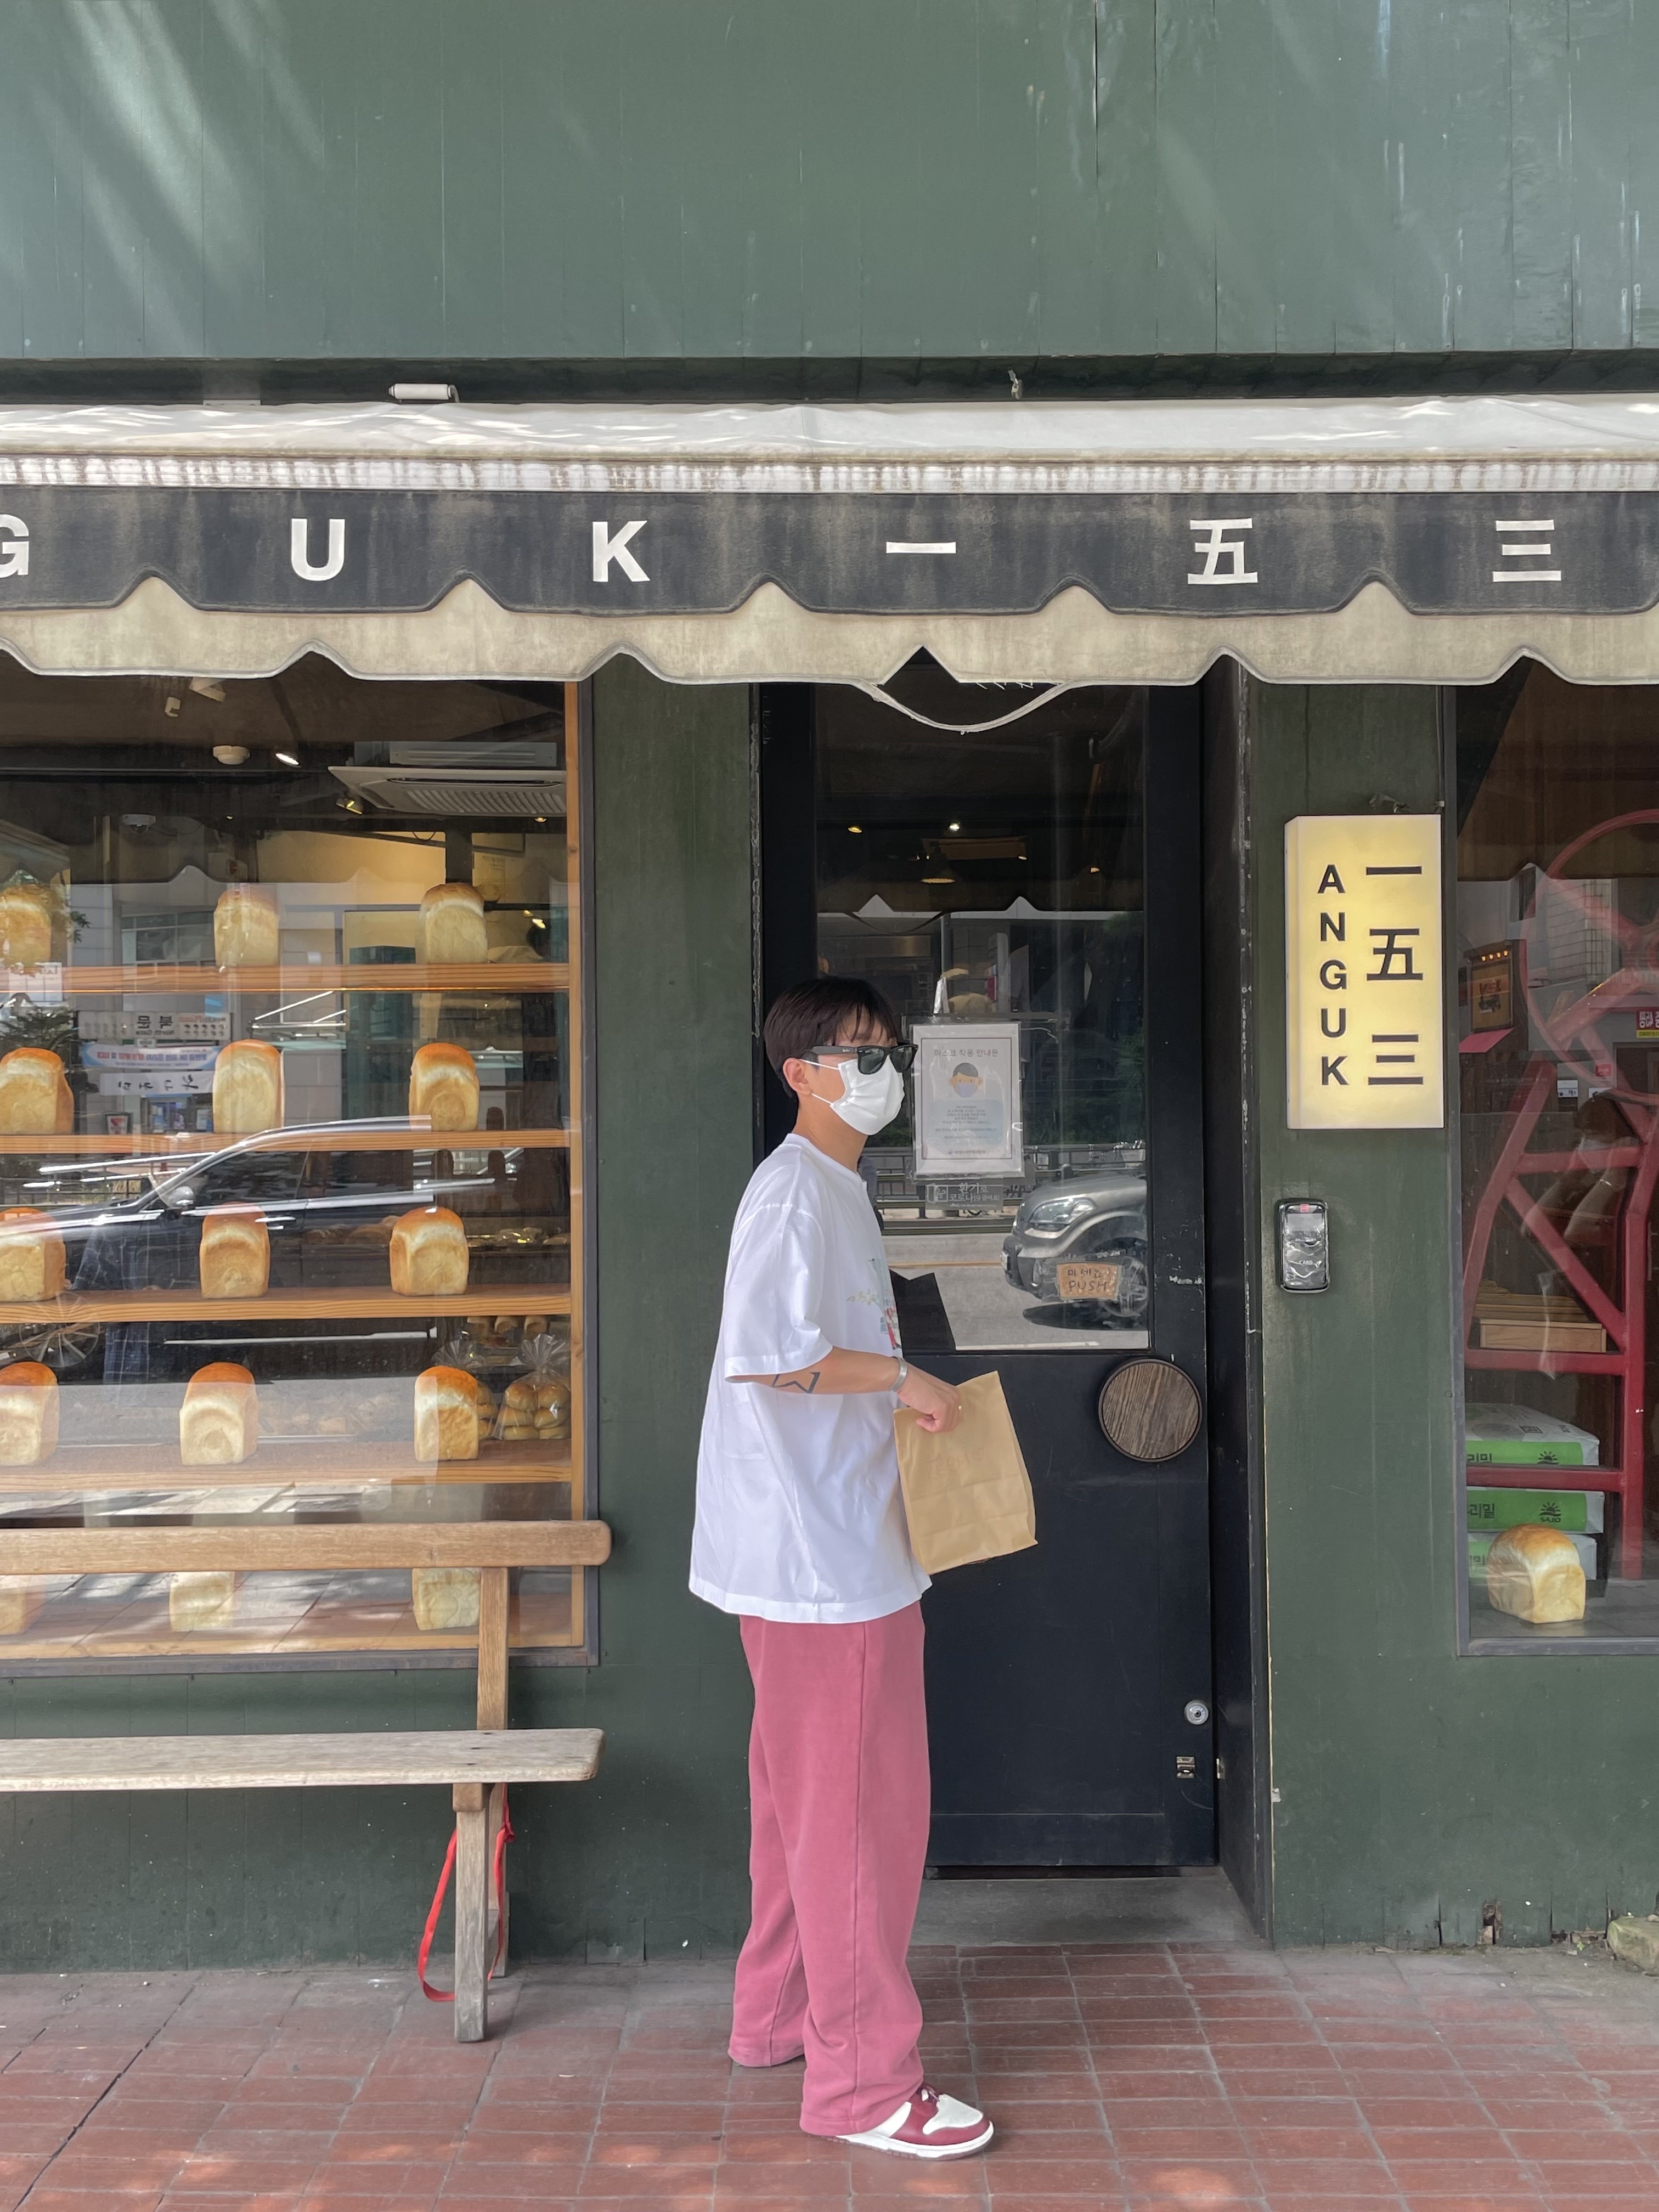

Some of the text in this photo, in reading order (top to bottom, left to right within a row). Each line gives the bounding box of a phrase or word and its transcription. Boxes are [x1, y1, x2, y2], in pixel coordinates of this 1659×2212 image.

[1317, 864, 1348, 1086] ANGUK
[1365, 865, 1424, 1086] 一五三
[934, 1049, 957, 1057] 마스크
[958, 1182, 989, 1194] 환기로
[949, 1193, 981, 1203] 코로나19
[1069, 1280, 1107, 1292] PUSH
[1467, 1503, 1496, 1519] 리밀
